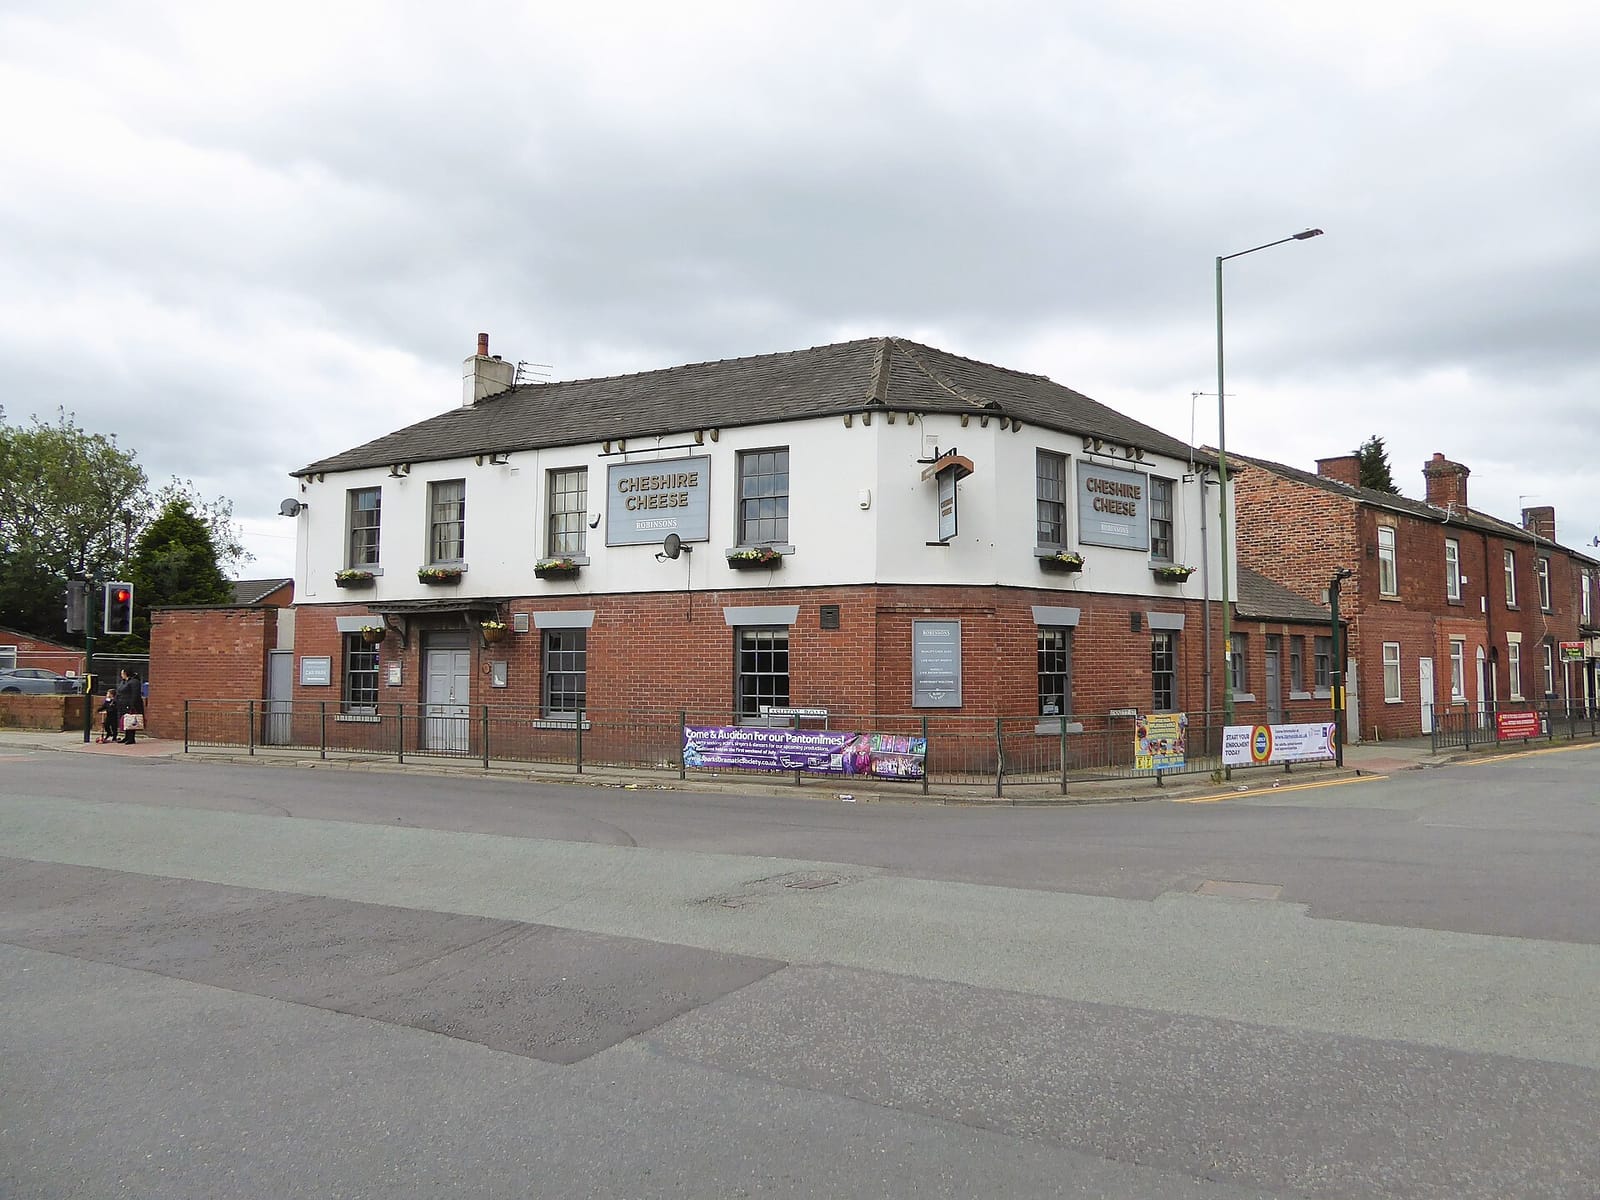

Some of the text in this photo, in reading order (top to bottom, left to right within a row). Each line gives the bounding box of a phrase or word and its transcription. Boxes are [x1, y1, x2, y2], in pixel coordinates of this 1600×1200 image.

[617, 472, 699, 493] CHESHIRE
[1086, 477, 1142, 500] CHESHIRE
[625, 492, 689, 511] CHEESE
[1093, 497, 1136, 517] CHEESE
[636, 519, 678, 529] ROBINSONS
[686, 728, 709, 738] Come
[710, 730, 717, 738] &
[718, 729, 753, 740] Audition
[769, 734, 785, 742] our
[785, 732, 845, 746] Pantomimes!
